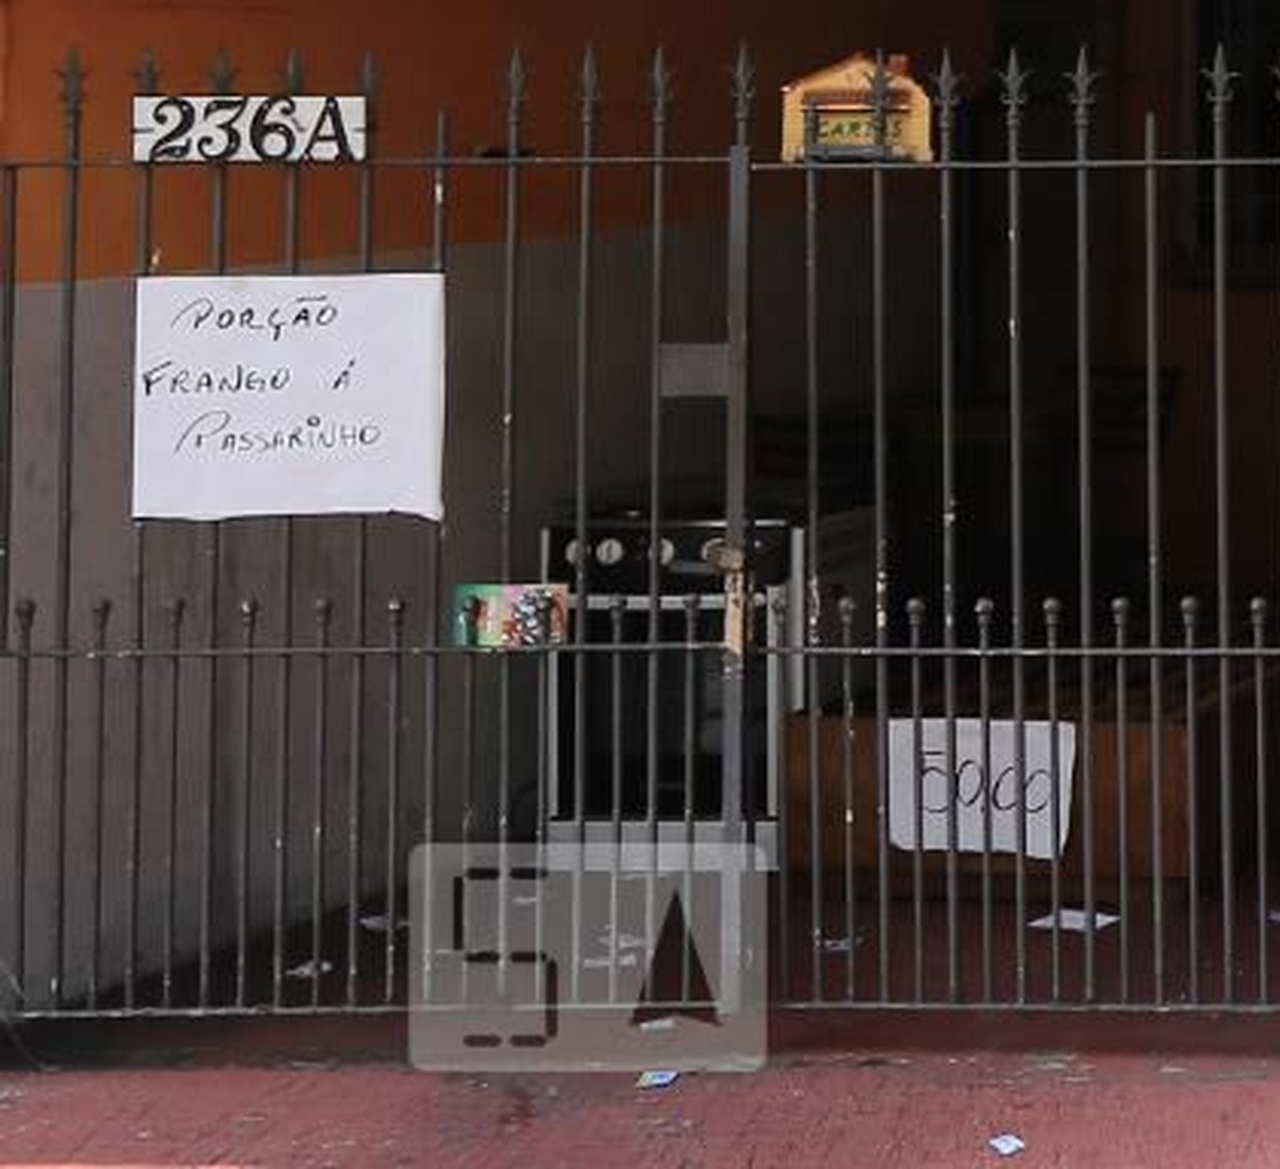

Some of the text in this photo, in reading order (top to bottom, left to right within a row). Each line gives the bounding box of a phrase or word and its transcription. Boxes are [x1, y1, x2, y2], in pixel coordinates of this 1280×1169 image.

[150, 96, 354, 163] 236A
[171, 295, 338, 341] PORÇÃO
[141, 360, 291, 397] FRANGO
